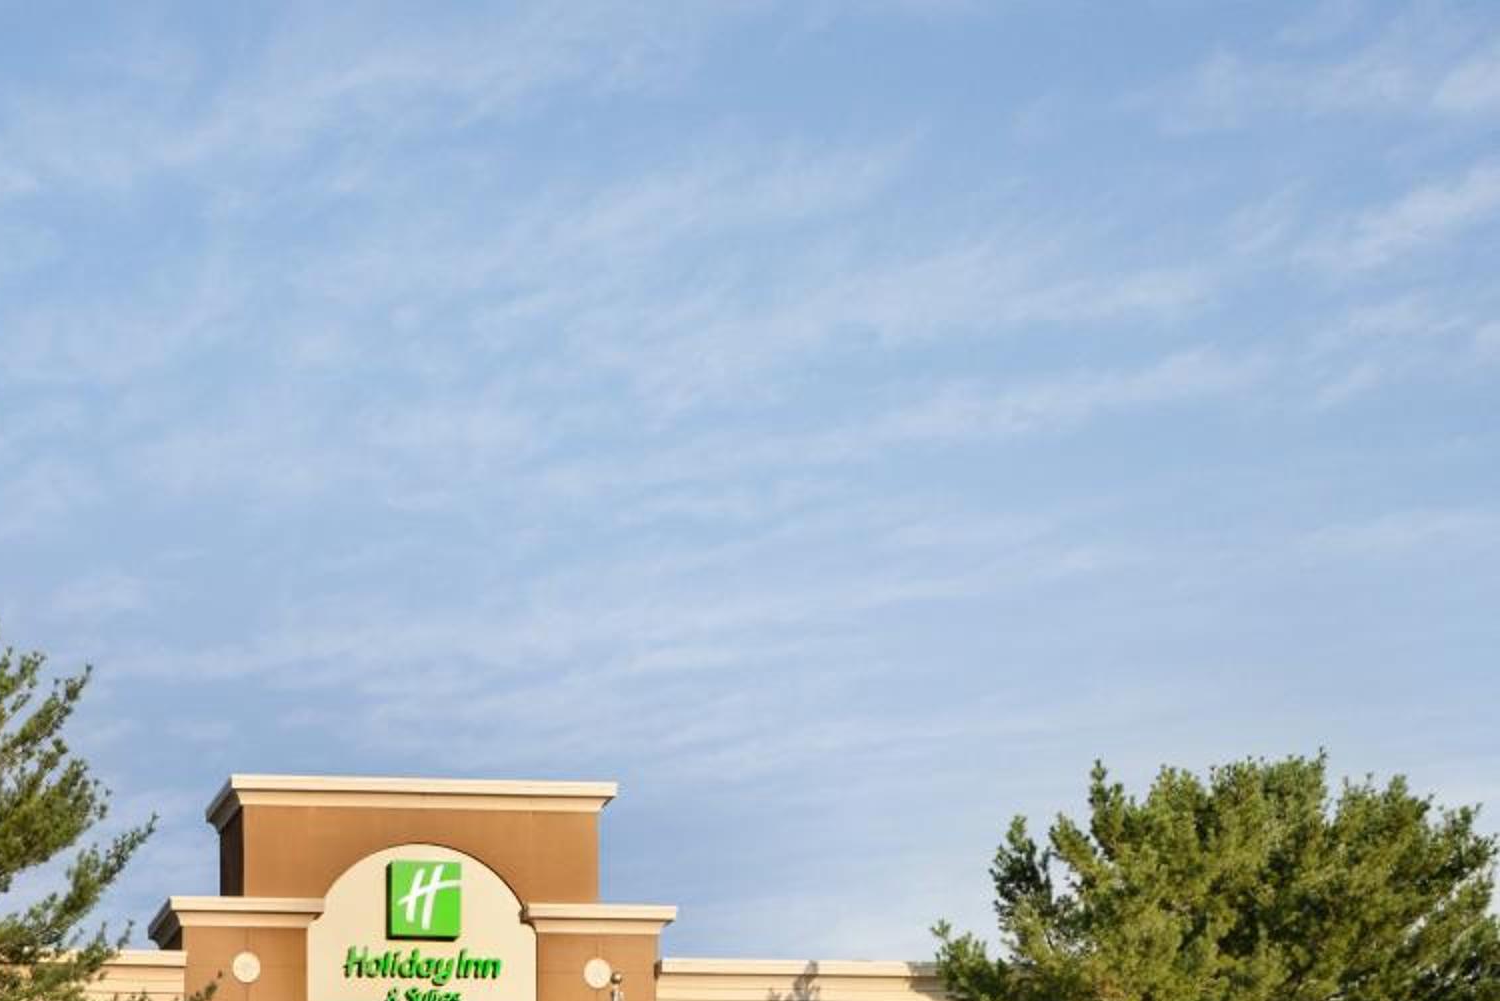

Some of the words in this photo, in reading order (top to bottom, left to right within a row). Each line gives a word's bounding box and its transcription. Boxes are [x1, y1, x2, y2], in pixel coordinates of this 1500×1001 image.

[397, 863, 462, 930] H
[343, 946, 455, 986] Holiday
[455, 948, 501, 979] Inn
